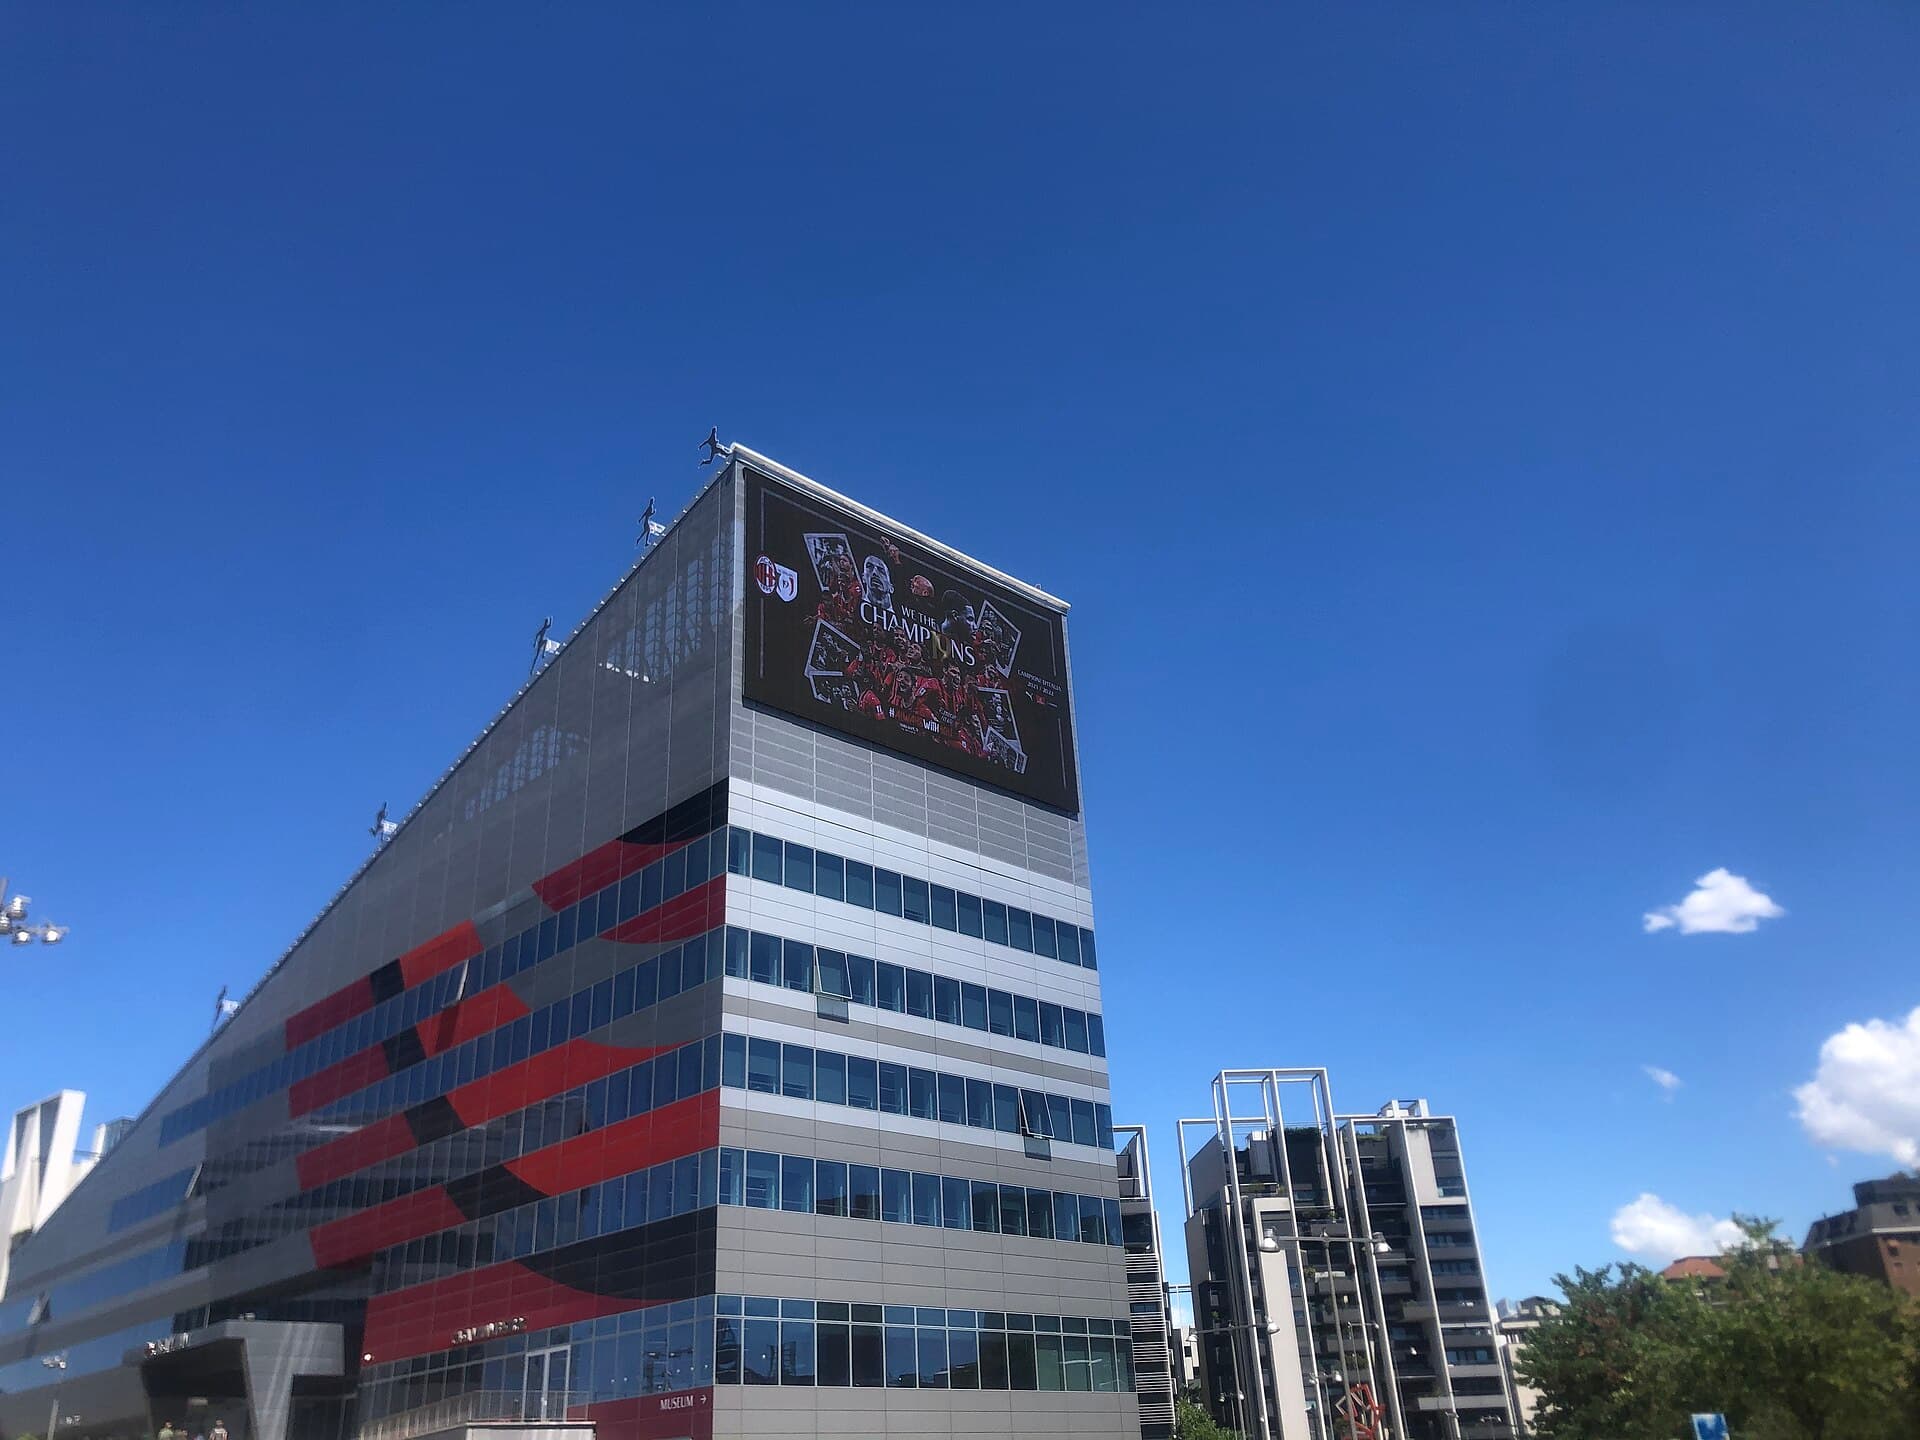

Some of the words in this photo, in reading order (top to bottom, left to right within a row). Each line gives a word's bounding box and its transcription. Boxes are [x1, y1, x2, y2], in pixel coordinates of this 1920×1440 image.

[901, 605, 916, 620] WE
[918, 612, 938, 631] THE
[660, 1395, 694, 1410] MUSEUM
